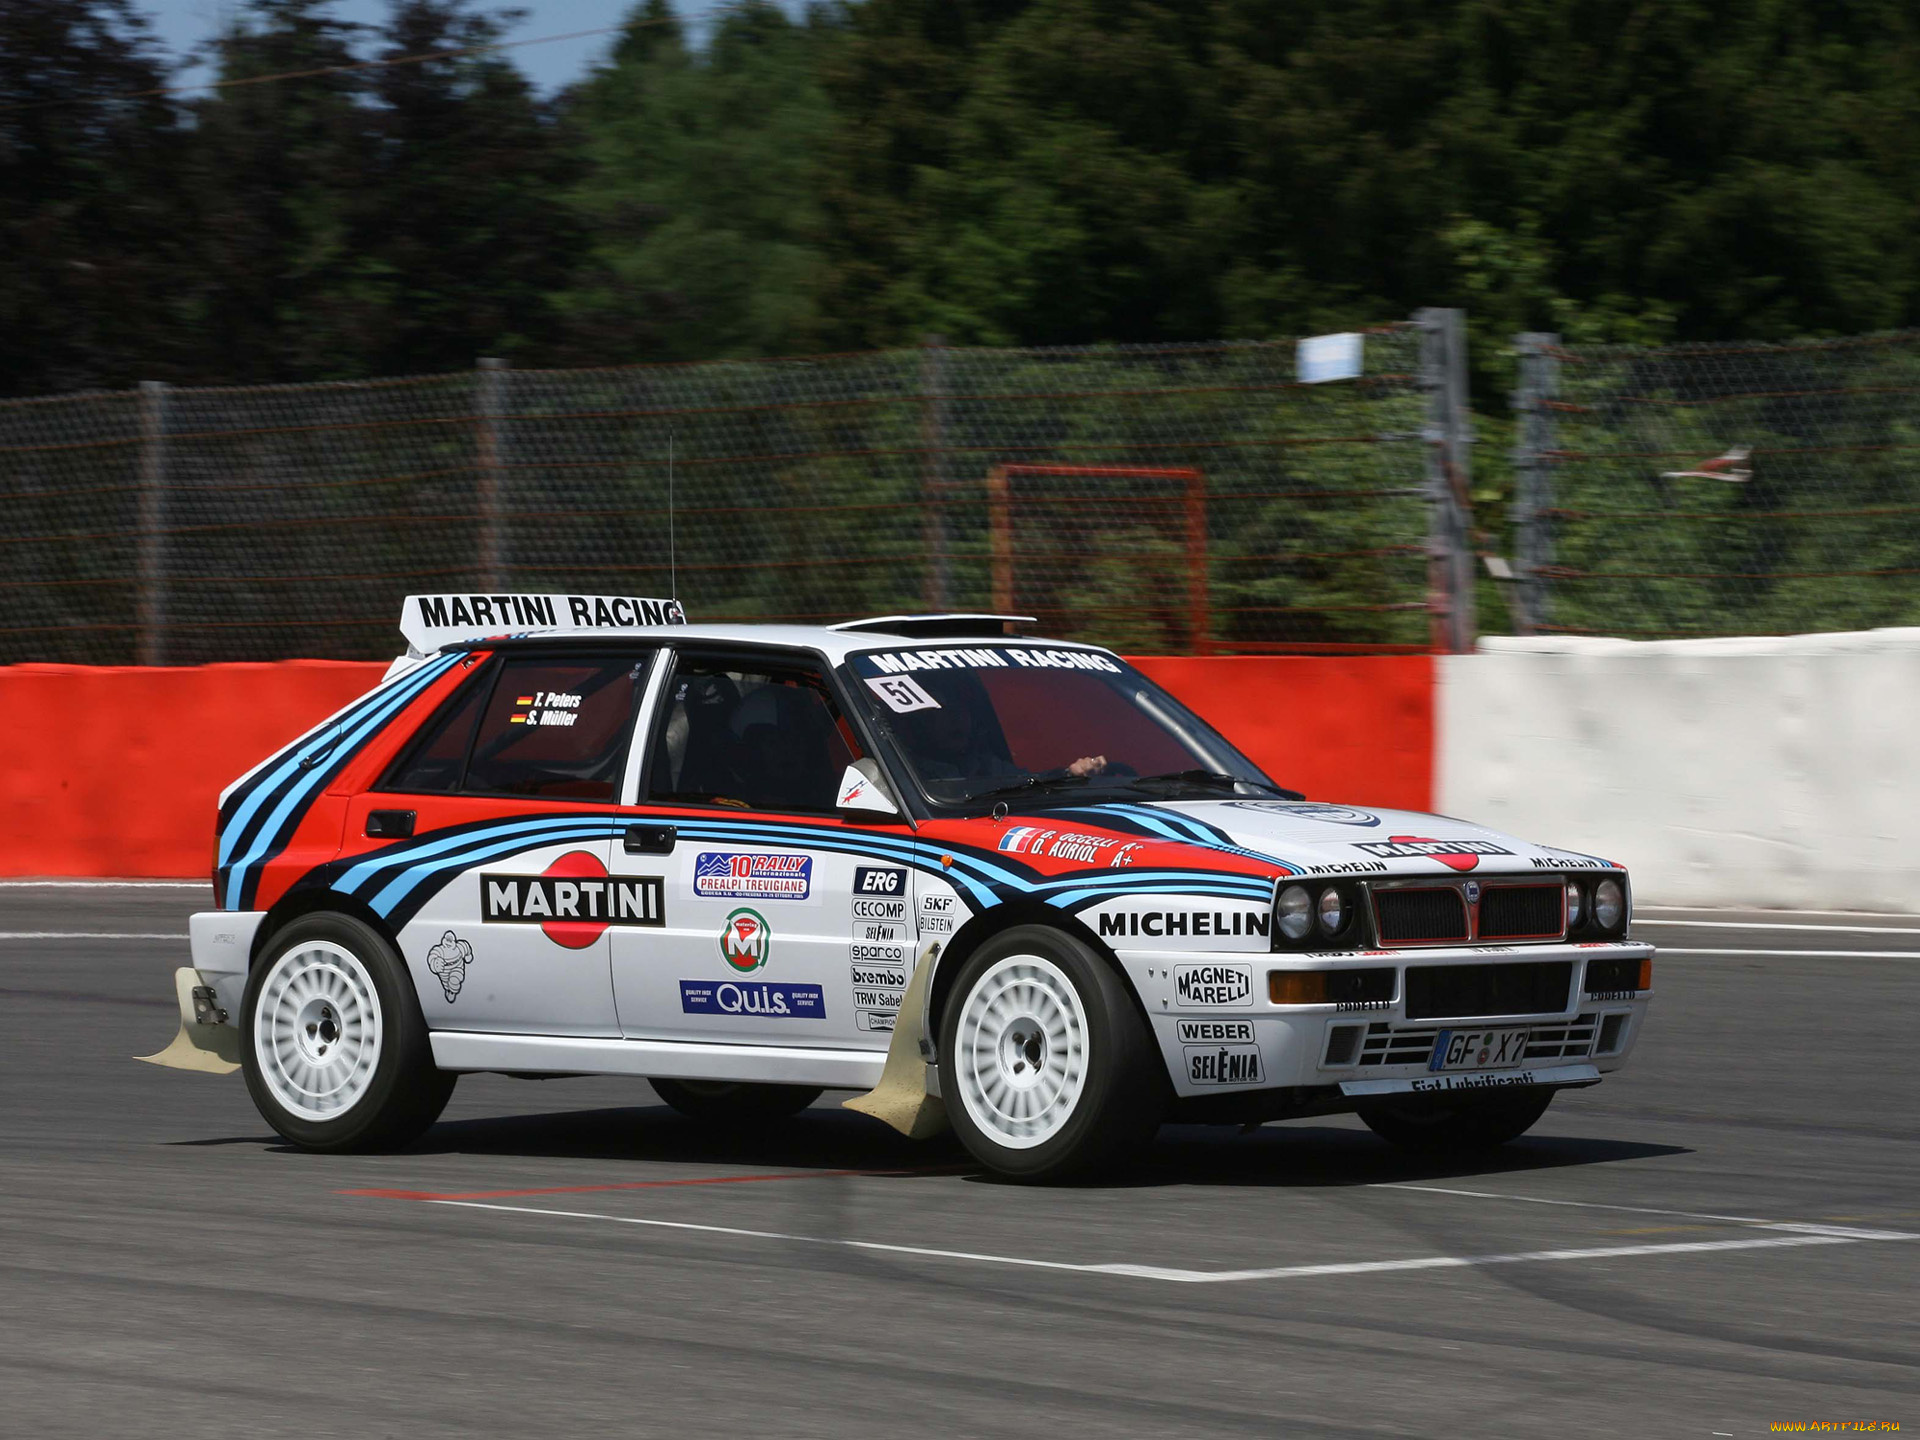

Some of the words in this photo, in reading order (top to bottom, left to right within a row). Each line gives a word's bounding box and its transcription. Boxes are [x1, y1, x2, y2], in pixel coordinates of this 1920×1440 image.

[418, 597, 557, 628] MARTINI
[567, 597, 684, 627] RACING
[868, 650, 1008, 674] MARTINI
[1005, 649, 1122, 674] RACING
[534, 692, 543, 707] T.
[544, 692, 582, 708] Peters
[879, 680, 925, 706] 51
[526, 711, 537, 725] S.
[540, 710, 578, 726] Müller
[1040, 831, 1057, 840] B.
[1121, 842, 1144, 851] A+
[1362, 841, 1509, 857] MARTINI
[1030, 839, 1045, 855] D.
[1048, 841, 1098, 863] AURIOL
[1110, 851, 1133, 868] A+
[753, 855, 808, 872] RALLY
[1308, 861, 1388, 875] MICHELIN
[1531, 857, 1598, 869] MICHELIN
[701, 878, 741, 891] PREALPI
[746, 879, 804, 892] TREVIGIANE
[862, 871, 898, 892] ERG
[488, 881, 657, 919] MARTINI
[924, 896, 953, 911] SKF
[854, 901, 904, 918] CECOMP
[920, 916, 952, 931] BILSTEIN
[1099, 912, 1269, 937] MICHELIN
[852, 945, 902, 961] sparco
[852, 967, 905, 986] brembo
[1178, 967, 1249, 988] MAGNETI
[855, 992, 876, 1006] TRW
[1181, 1024, 1250, 1039] WEBER
[1446, 1034, 1480, 1065] GF
[1493, 1031, 1527, 1063] X7
[1191, 1047, 1258, 1082] SELÈNIA
[1411, 1077, 1442, 1091] Fiat
